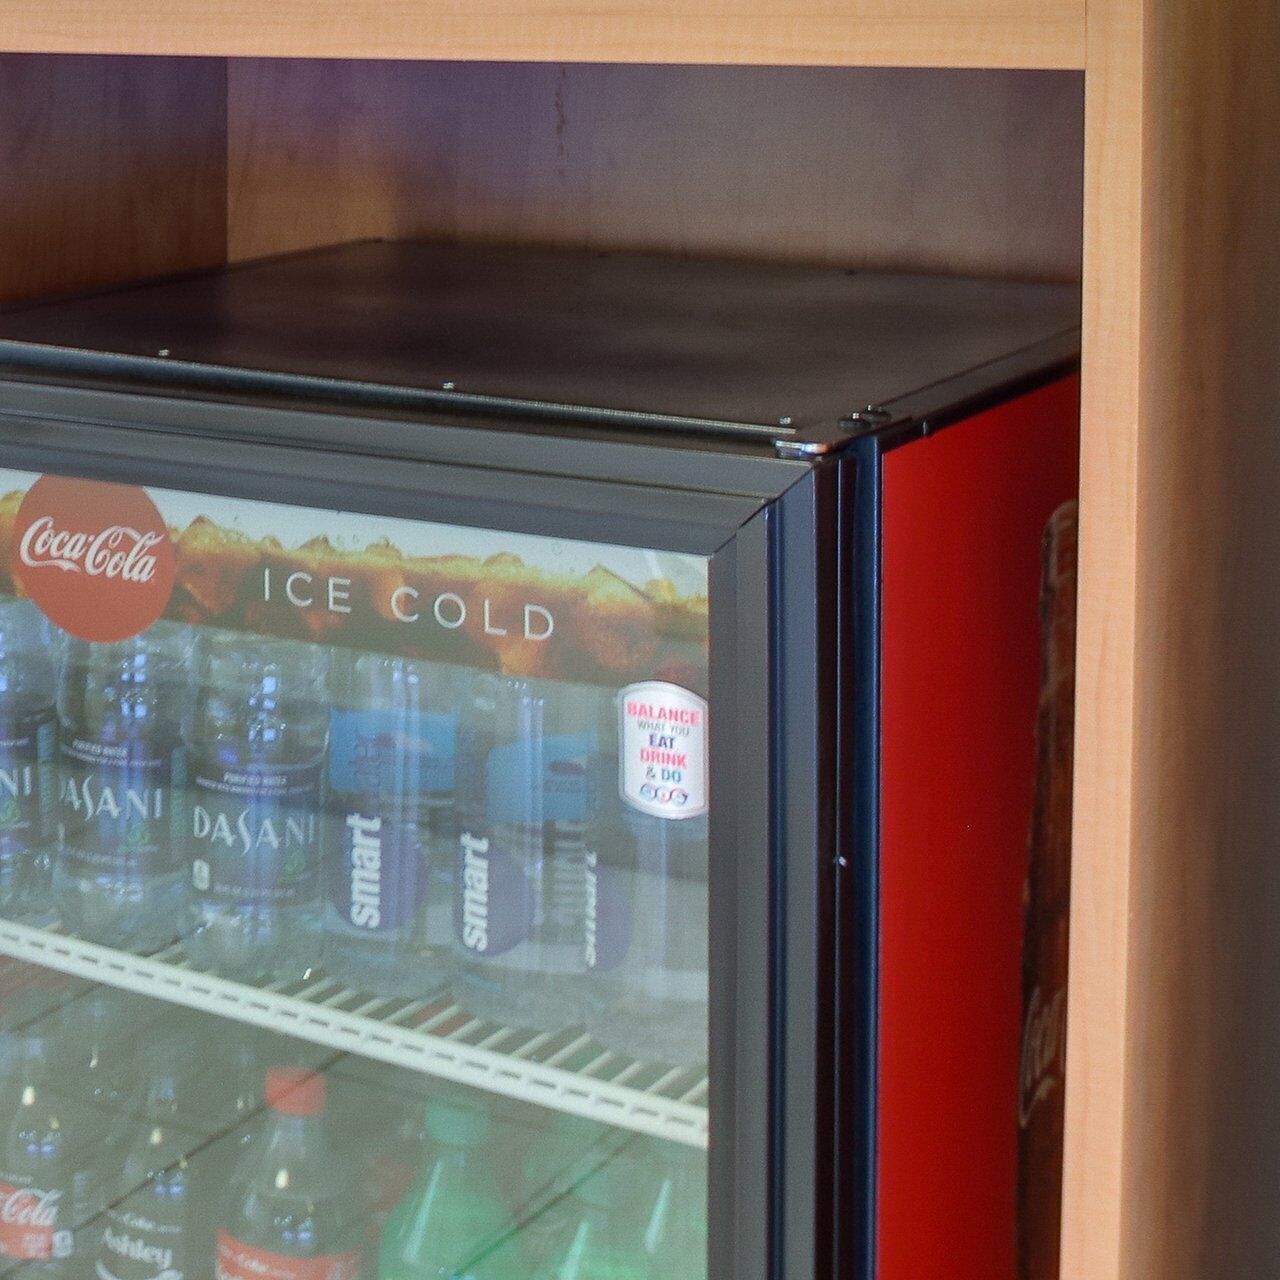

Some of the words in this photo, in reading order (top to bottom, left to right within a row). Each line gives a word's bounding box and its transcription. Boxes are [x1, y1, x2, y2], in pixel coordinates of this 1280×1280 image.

[19, 516, 165, 584] Coca-Cola
[263, 567, 353, 614] ICE
[389, 585, 555, 641] COLD
[627, 700, 700, 727] BALANCE
[640, 746, 689, 768] DRINK
[648, 733, 676, 749] EAT
[661, 767, 682, 783] DO
[192, 805, 315, 856] DASANI
[346, 812, 382, 930] smart
[460, 831, 489, 953] smart
